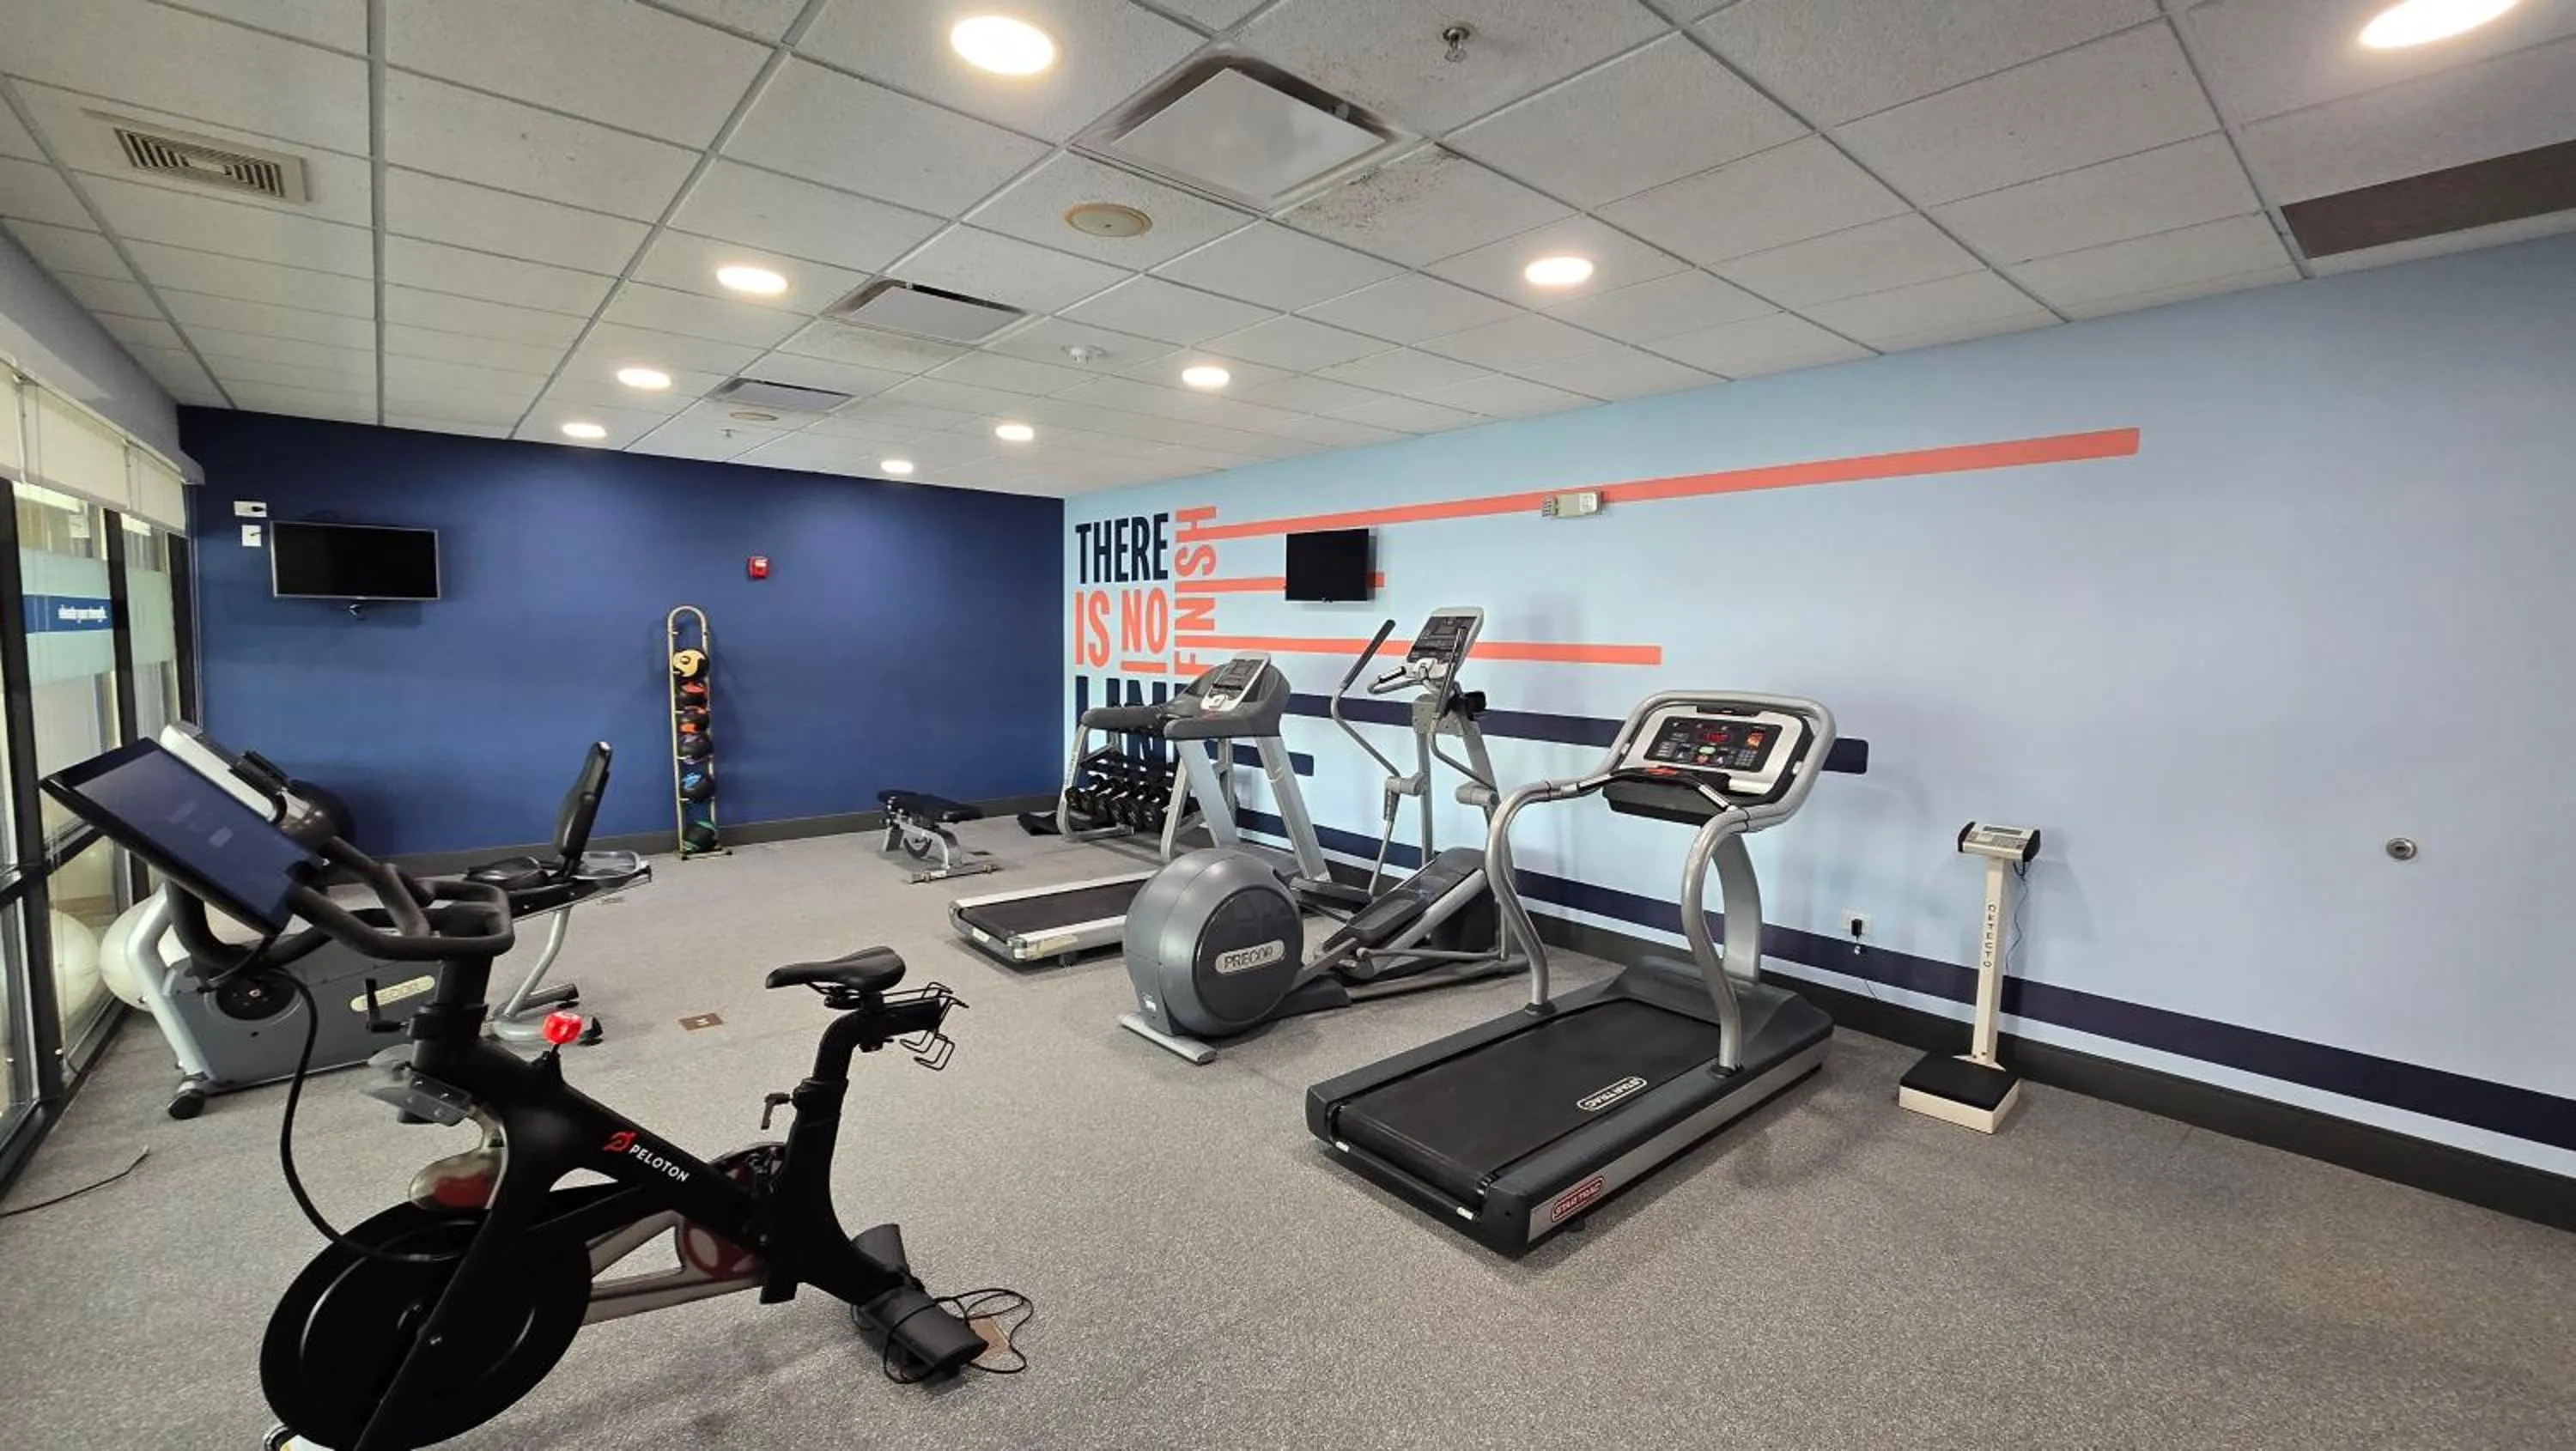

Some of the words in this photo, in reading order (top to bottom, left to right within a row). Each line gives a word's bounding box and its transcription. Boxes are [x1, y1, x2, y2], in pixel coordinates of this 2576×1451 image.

[1075, 513, 1169, 584] THERE
[1174, 506, 1217, 676] FINISH
[1075, 590, 1110, 668] IS
[1121, 587, 1169, 654] NO
[1224, 945, 1274, 969] PRECOR
[1983, 904, 1996, 968] DETECTO
[629, 1144, 690, 1182] PELOTON
